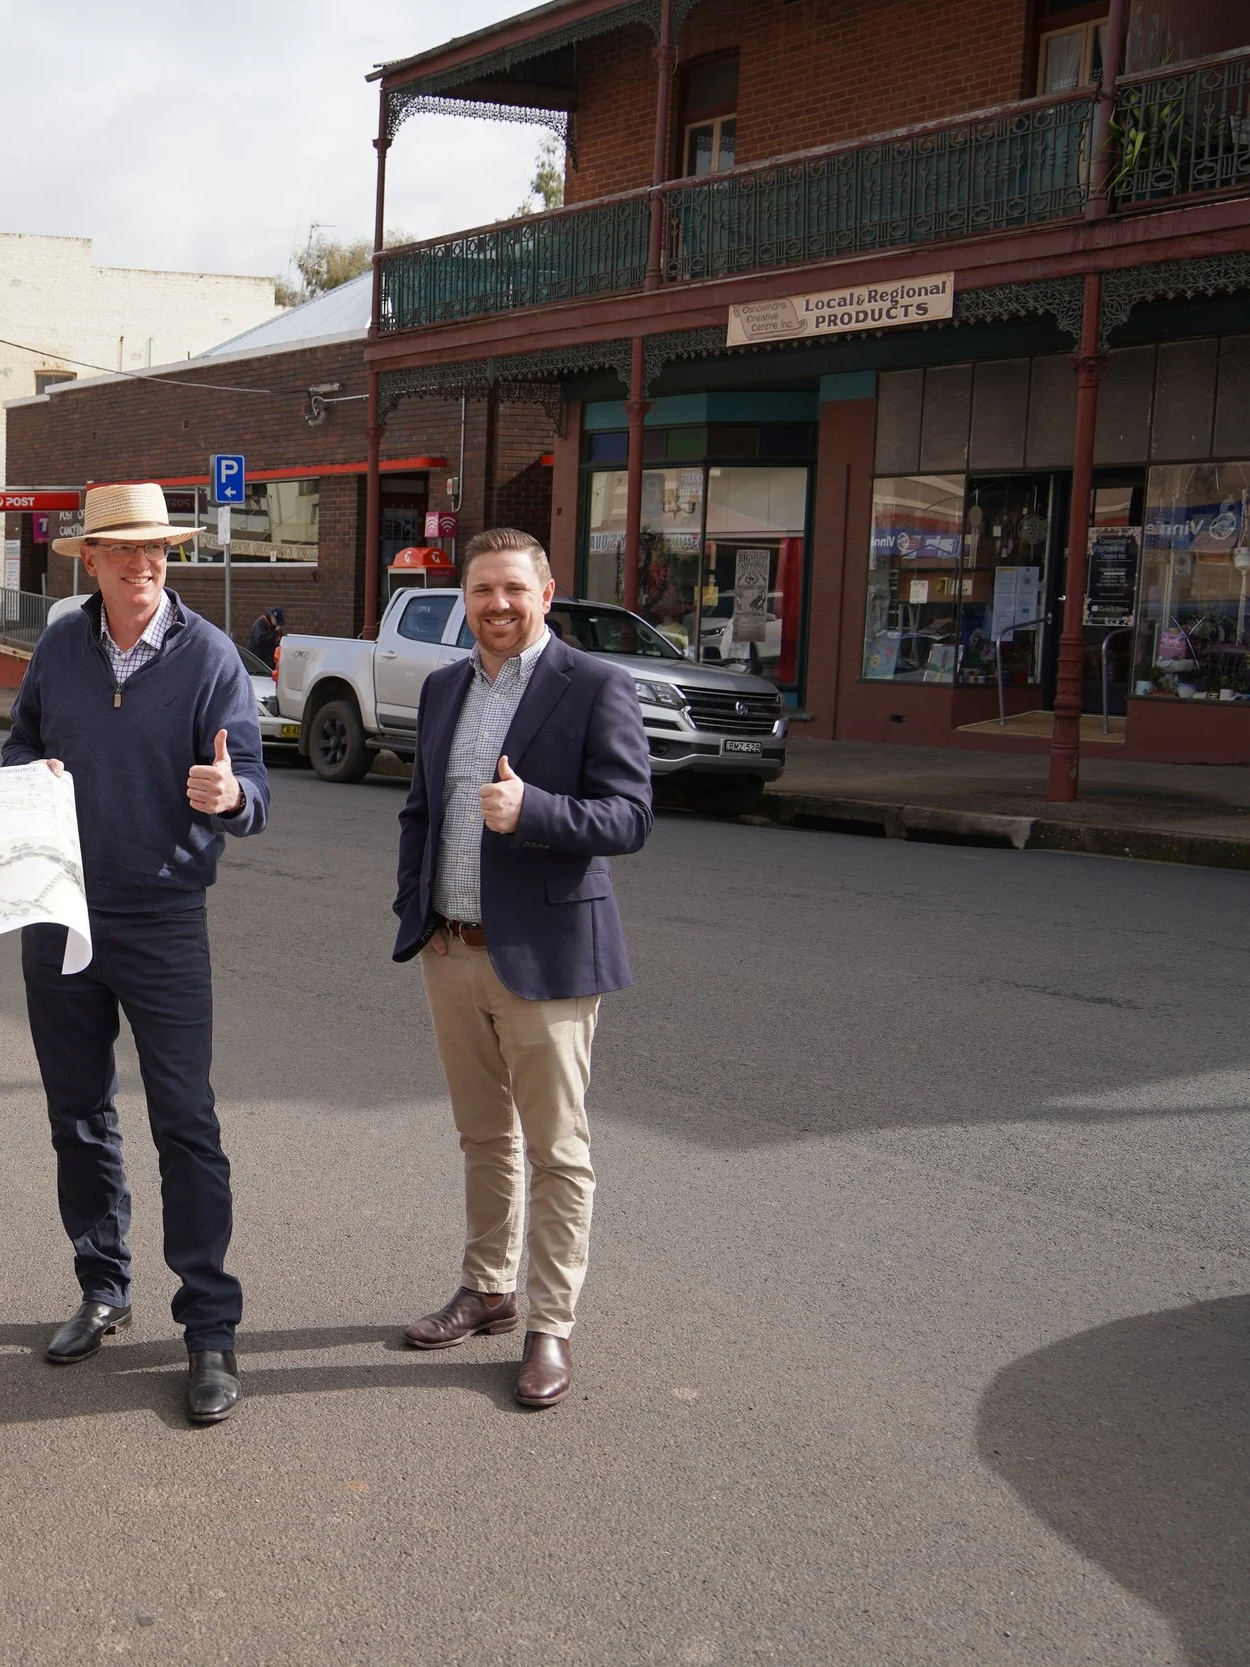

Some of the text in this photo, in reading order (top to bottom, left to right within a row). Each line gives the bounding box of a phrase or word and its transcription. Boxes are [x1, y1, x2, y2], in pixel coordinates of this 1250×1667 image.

[804, 280, 947, 313] Local & Regional
[746, 312, 779, 323] Creative
[814, 302, 929, 329] PRODUCTS
[751, 322, 778, 332] Centre
[221, 459, 239, 484] P
[5, 497, 35, 507] POST
